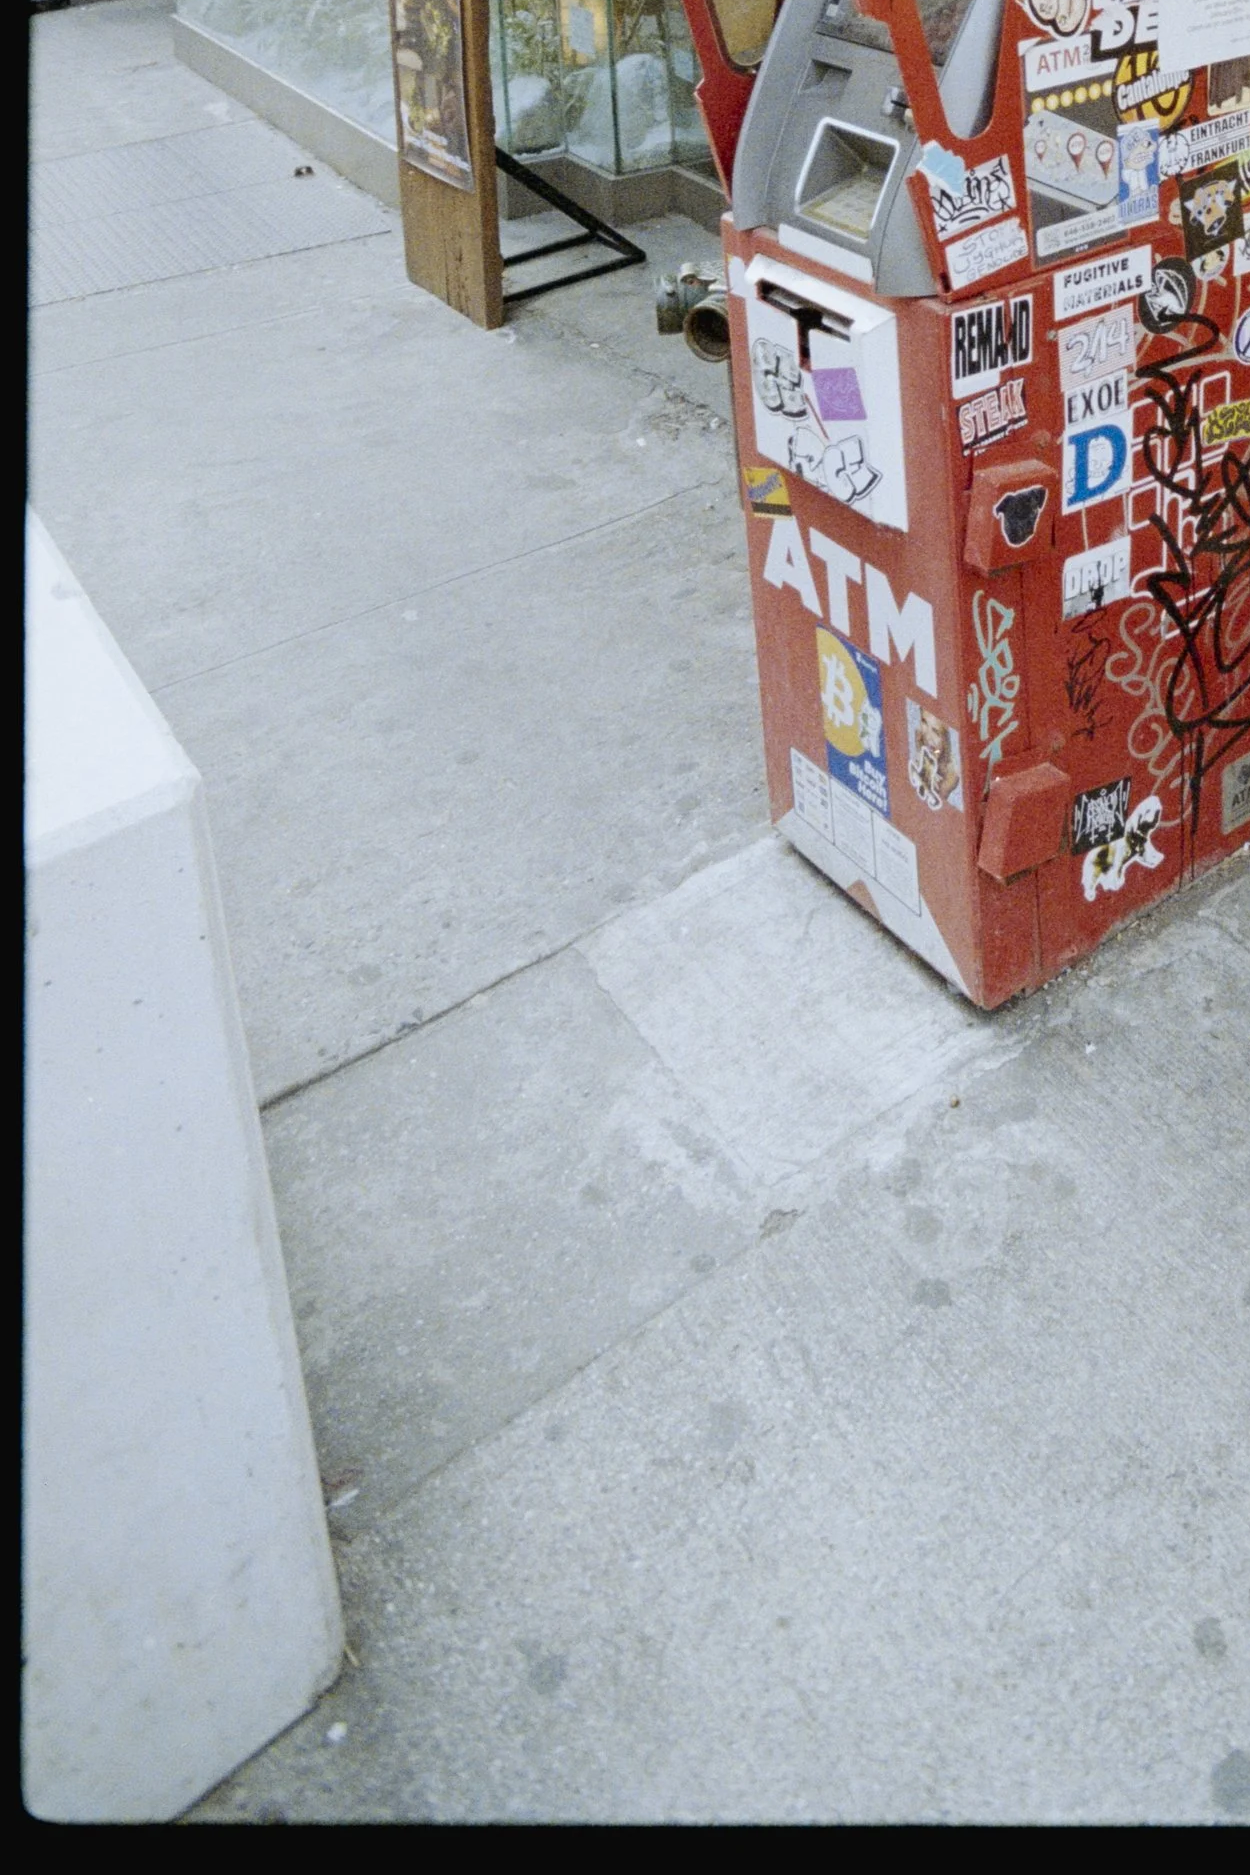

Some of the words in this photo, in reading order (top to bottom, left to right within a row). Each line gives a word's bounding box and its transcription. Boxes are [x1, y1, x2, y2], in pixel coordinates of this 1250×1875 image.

[1036, 47, 1081, 74] ATM
[1190, 110, 1250, 143] EINTRACHT
[1063, 275, 1144, 312] MATERIALS
[1064, 257, 1130, 289] FUGITIVE
[954, 299, 1030, 380] REMAND
[958, 378, 1027, 445] STEAK
[1067, 377, 1125, 425] EXOE
[1067, 424, 1128, 507] D
[1064, 550, 1128, 601] DROP
[762, 516, 938, 700] ATM
